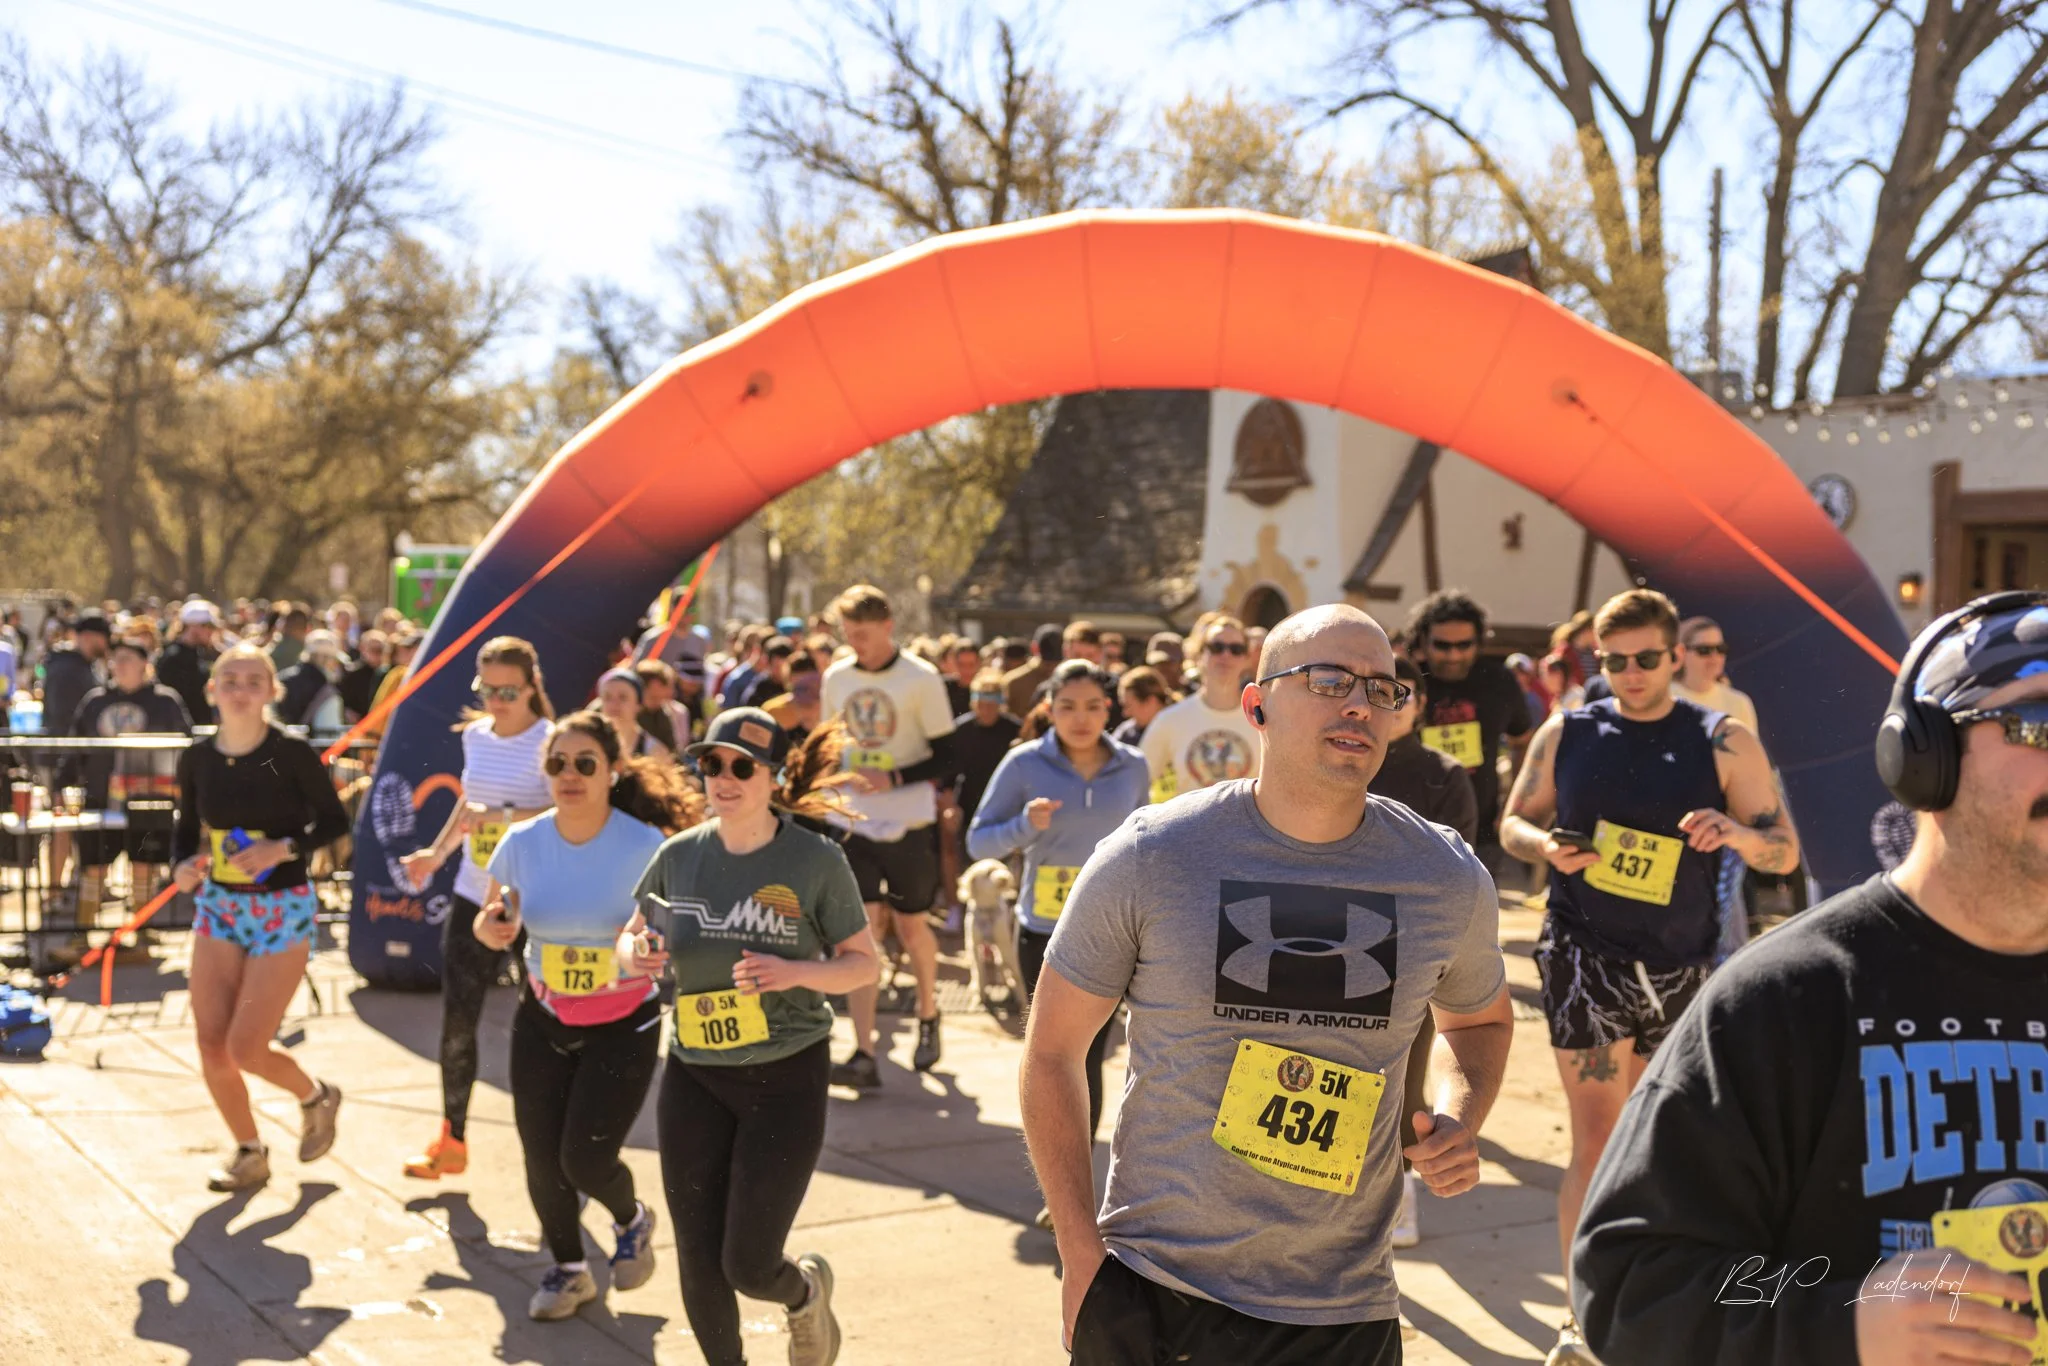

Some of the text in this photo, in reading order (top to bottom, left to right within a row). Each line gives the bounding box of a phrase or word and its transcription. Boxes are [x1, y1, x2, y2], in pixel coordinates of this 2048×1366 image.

[1611, 852, 1653, 880] 437
[563, 969, 593, 990] 173
[718, 994, 738, 1010] 5K
[700, 1016, 740, 1045] 108
[1213, 1005, 1389, 1030] UNDER ARMOUR
[1857, 1017, 2046, 1039] FOOTB
[1319, 1069, 1352, 1100] 5K
[1257, 1094, 1340, 1153] 434
[1231, 1145, 1342, 1181] Good for one Atypical Beverage 434
